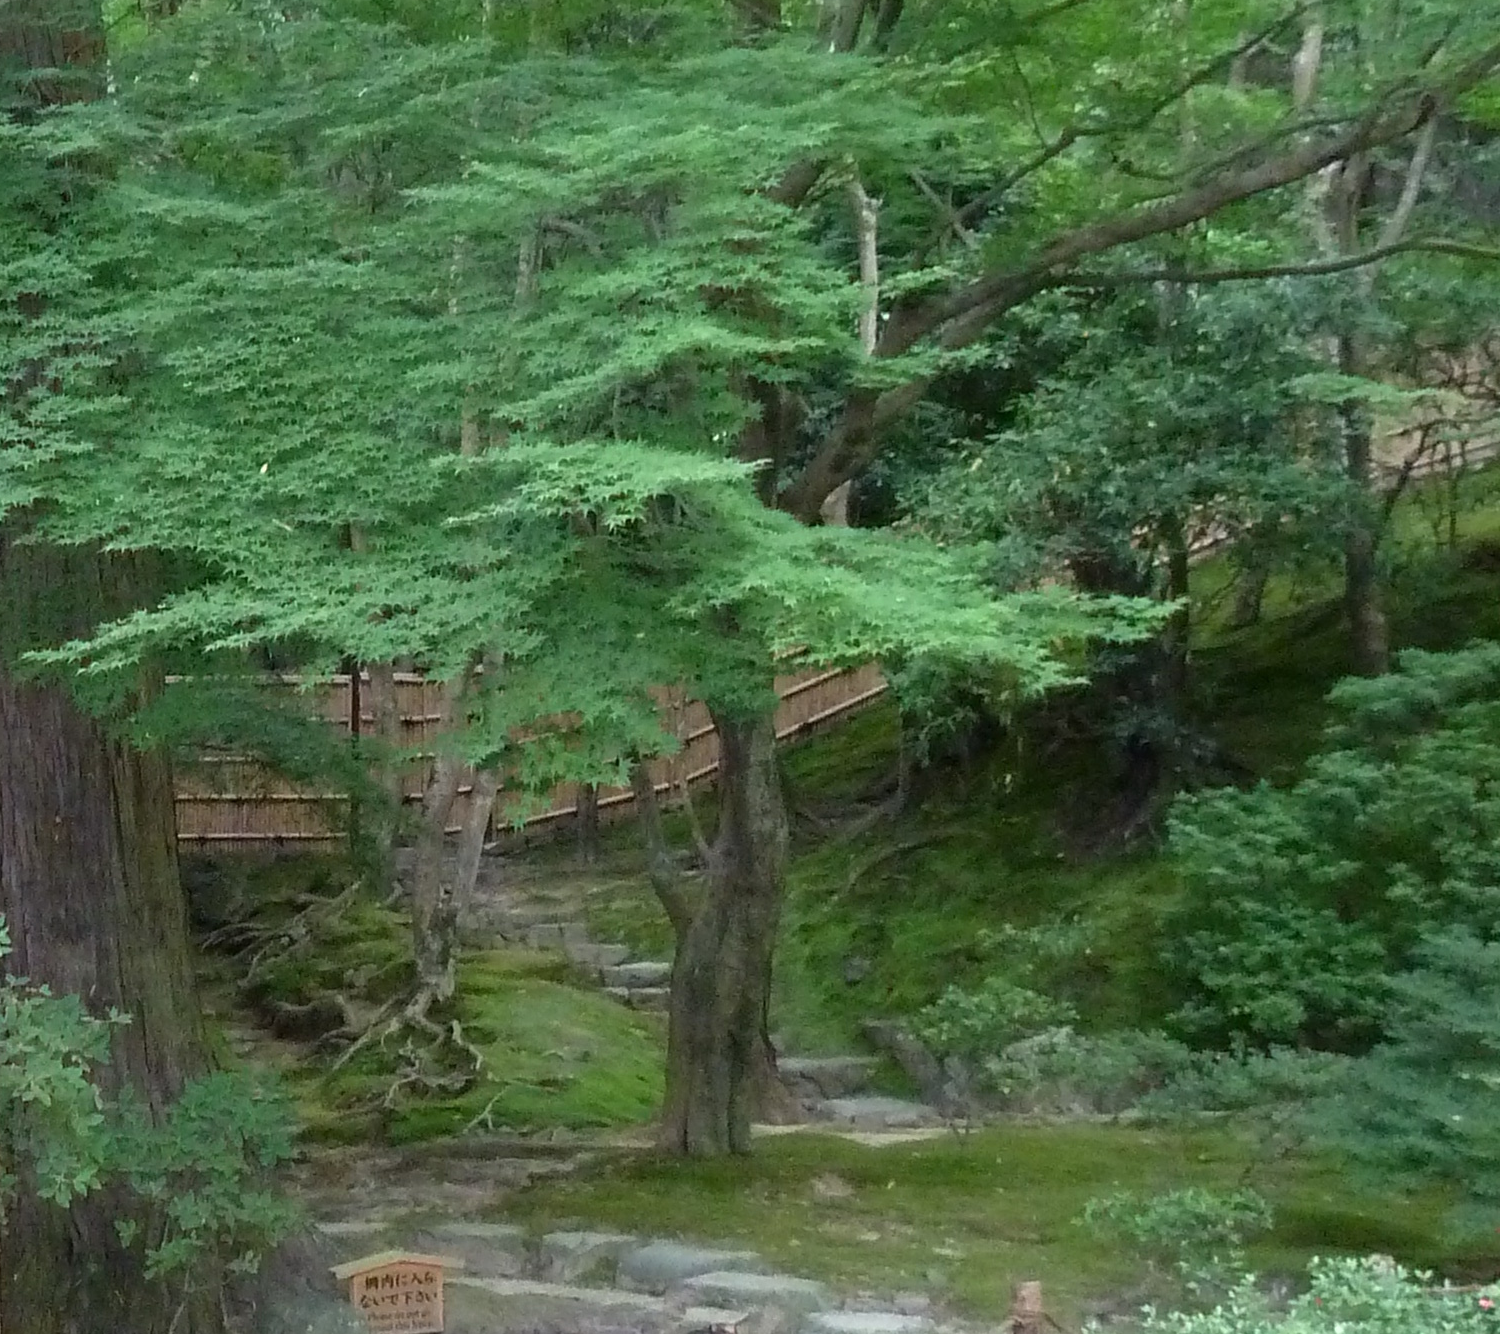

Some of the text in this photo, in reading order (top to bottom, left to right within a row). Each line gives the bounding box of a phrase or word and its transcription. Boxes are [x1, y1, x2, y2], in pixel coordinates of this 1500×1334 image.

[360, 1291, 438, 1309] ないで下さい
